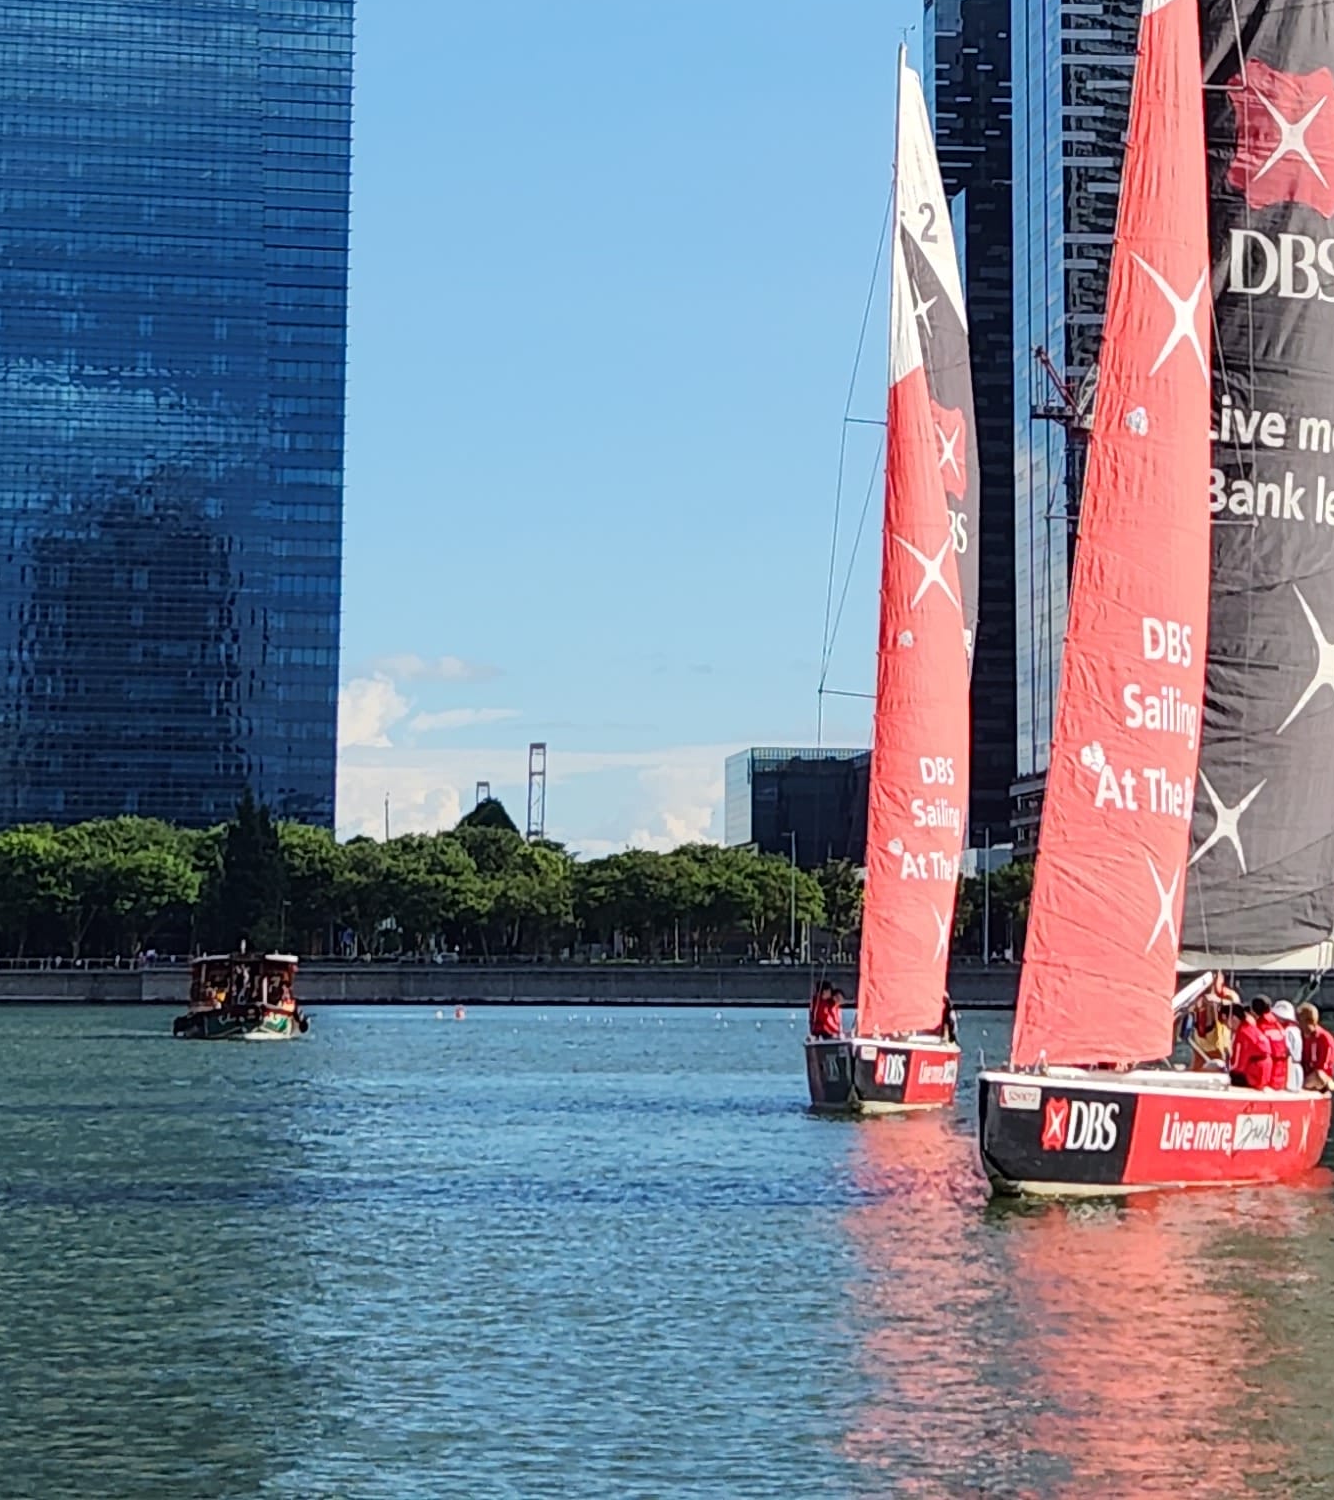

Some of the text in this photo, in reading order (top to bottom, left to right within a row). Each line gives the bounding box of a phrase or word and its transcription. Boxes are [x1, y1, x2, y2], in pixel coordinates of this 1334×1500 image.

[918, 202, 938, 244] 2
[1142, 617, 1192, 668] DBS
[1123, 683, 1197, 750] Sailing
[919, 756, 955, 786] DBS
[1094, 764, 1138, 810] At
[1143, 767, 1182, 817] The
[910, 798, 960, 837] Sailing
[900, 851, 928, 880] At
[883, 1053, 907, 1085] DBS
[1065, 1100, 1120, 1151] DBS
[1159, 1111, 1194, 1150] Live
[1193, 1120, 1233, 1158] more,
